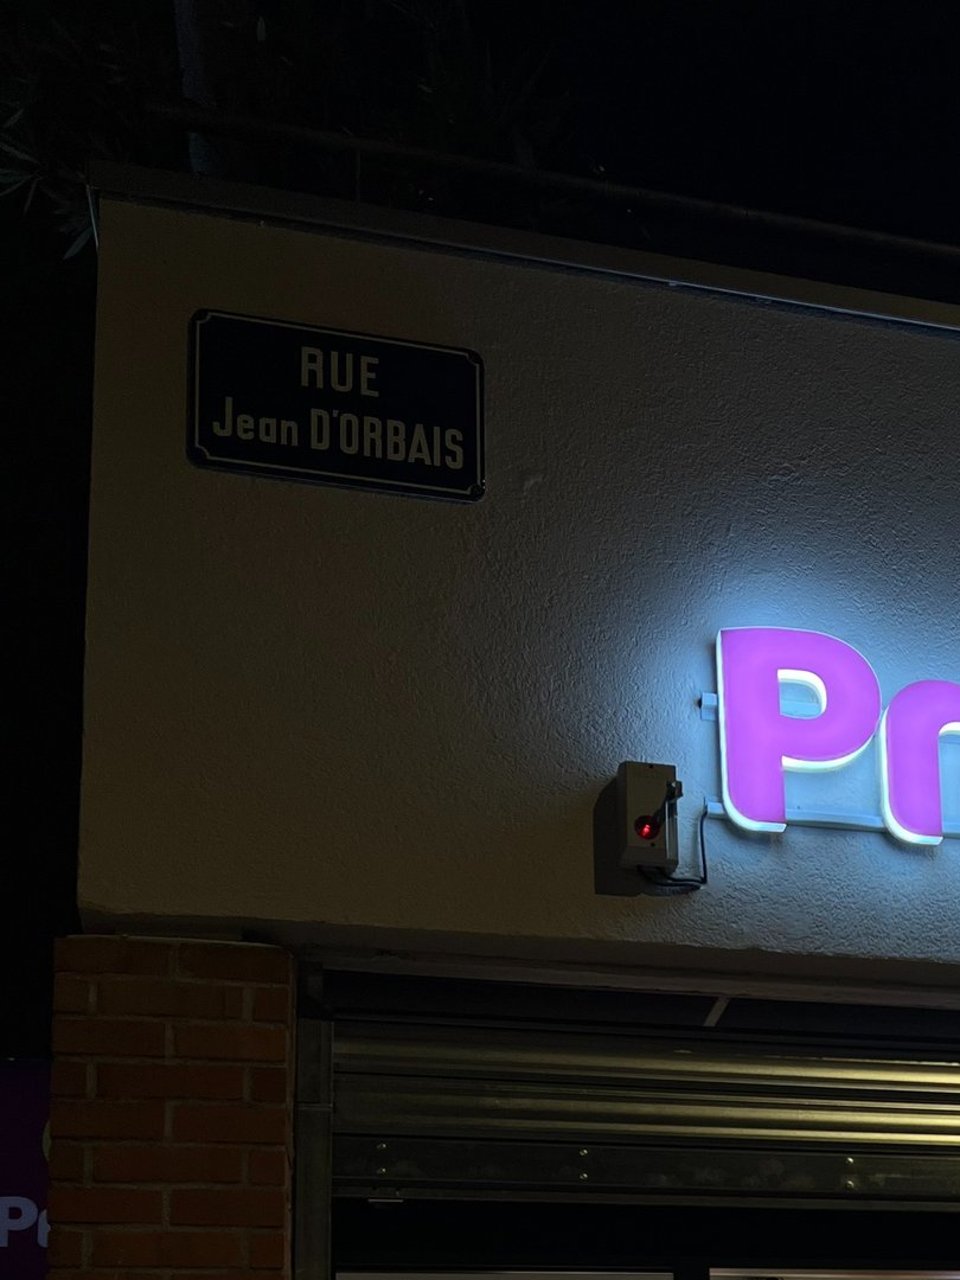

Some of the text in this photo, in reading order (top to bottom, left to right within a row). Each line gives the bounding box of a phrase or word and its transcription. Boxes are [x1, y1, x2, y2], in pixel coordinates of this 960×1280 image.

[300, 346, 380, 398] RUE
[212, 396, 465, 471] Jean D'ORBAIS
